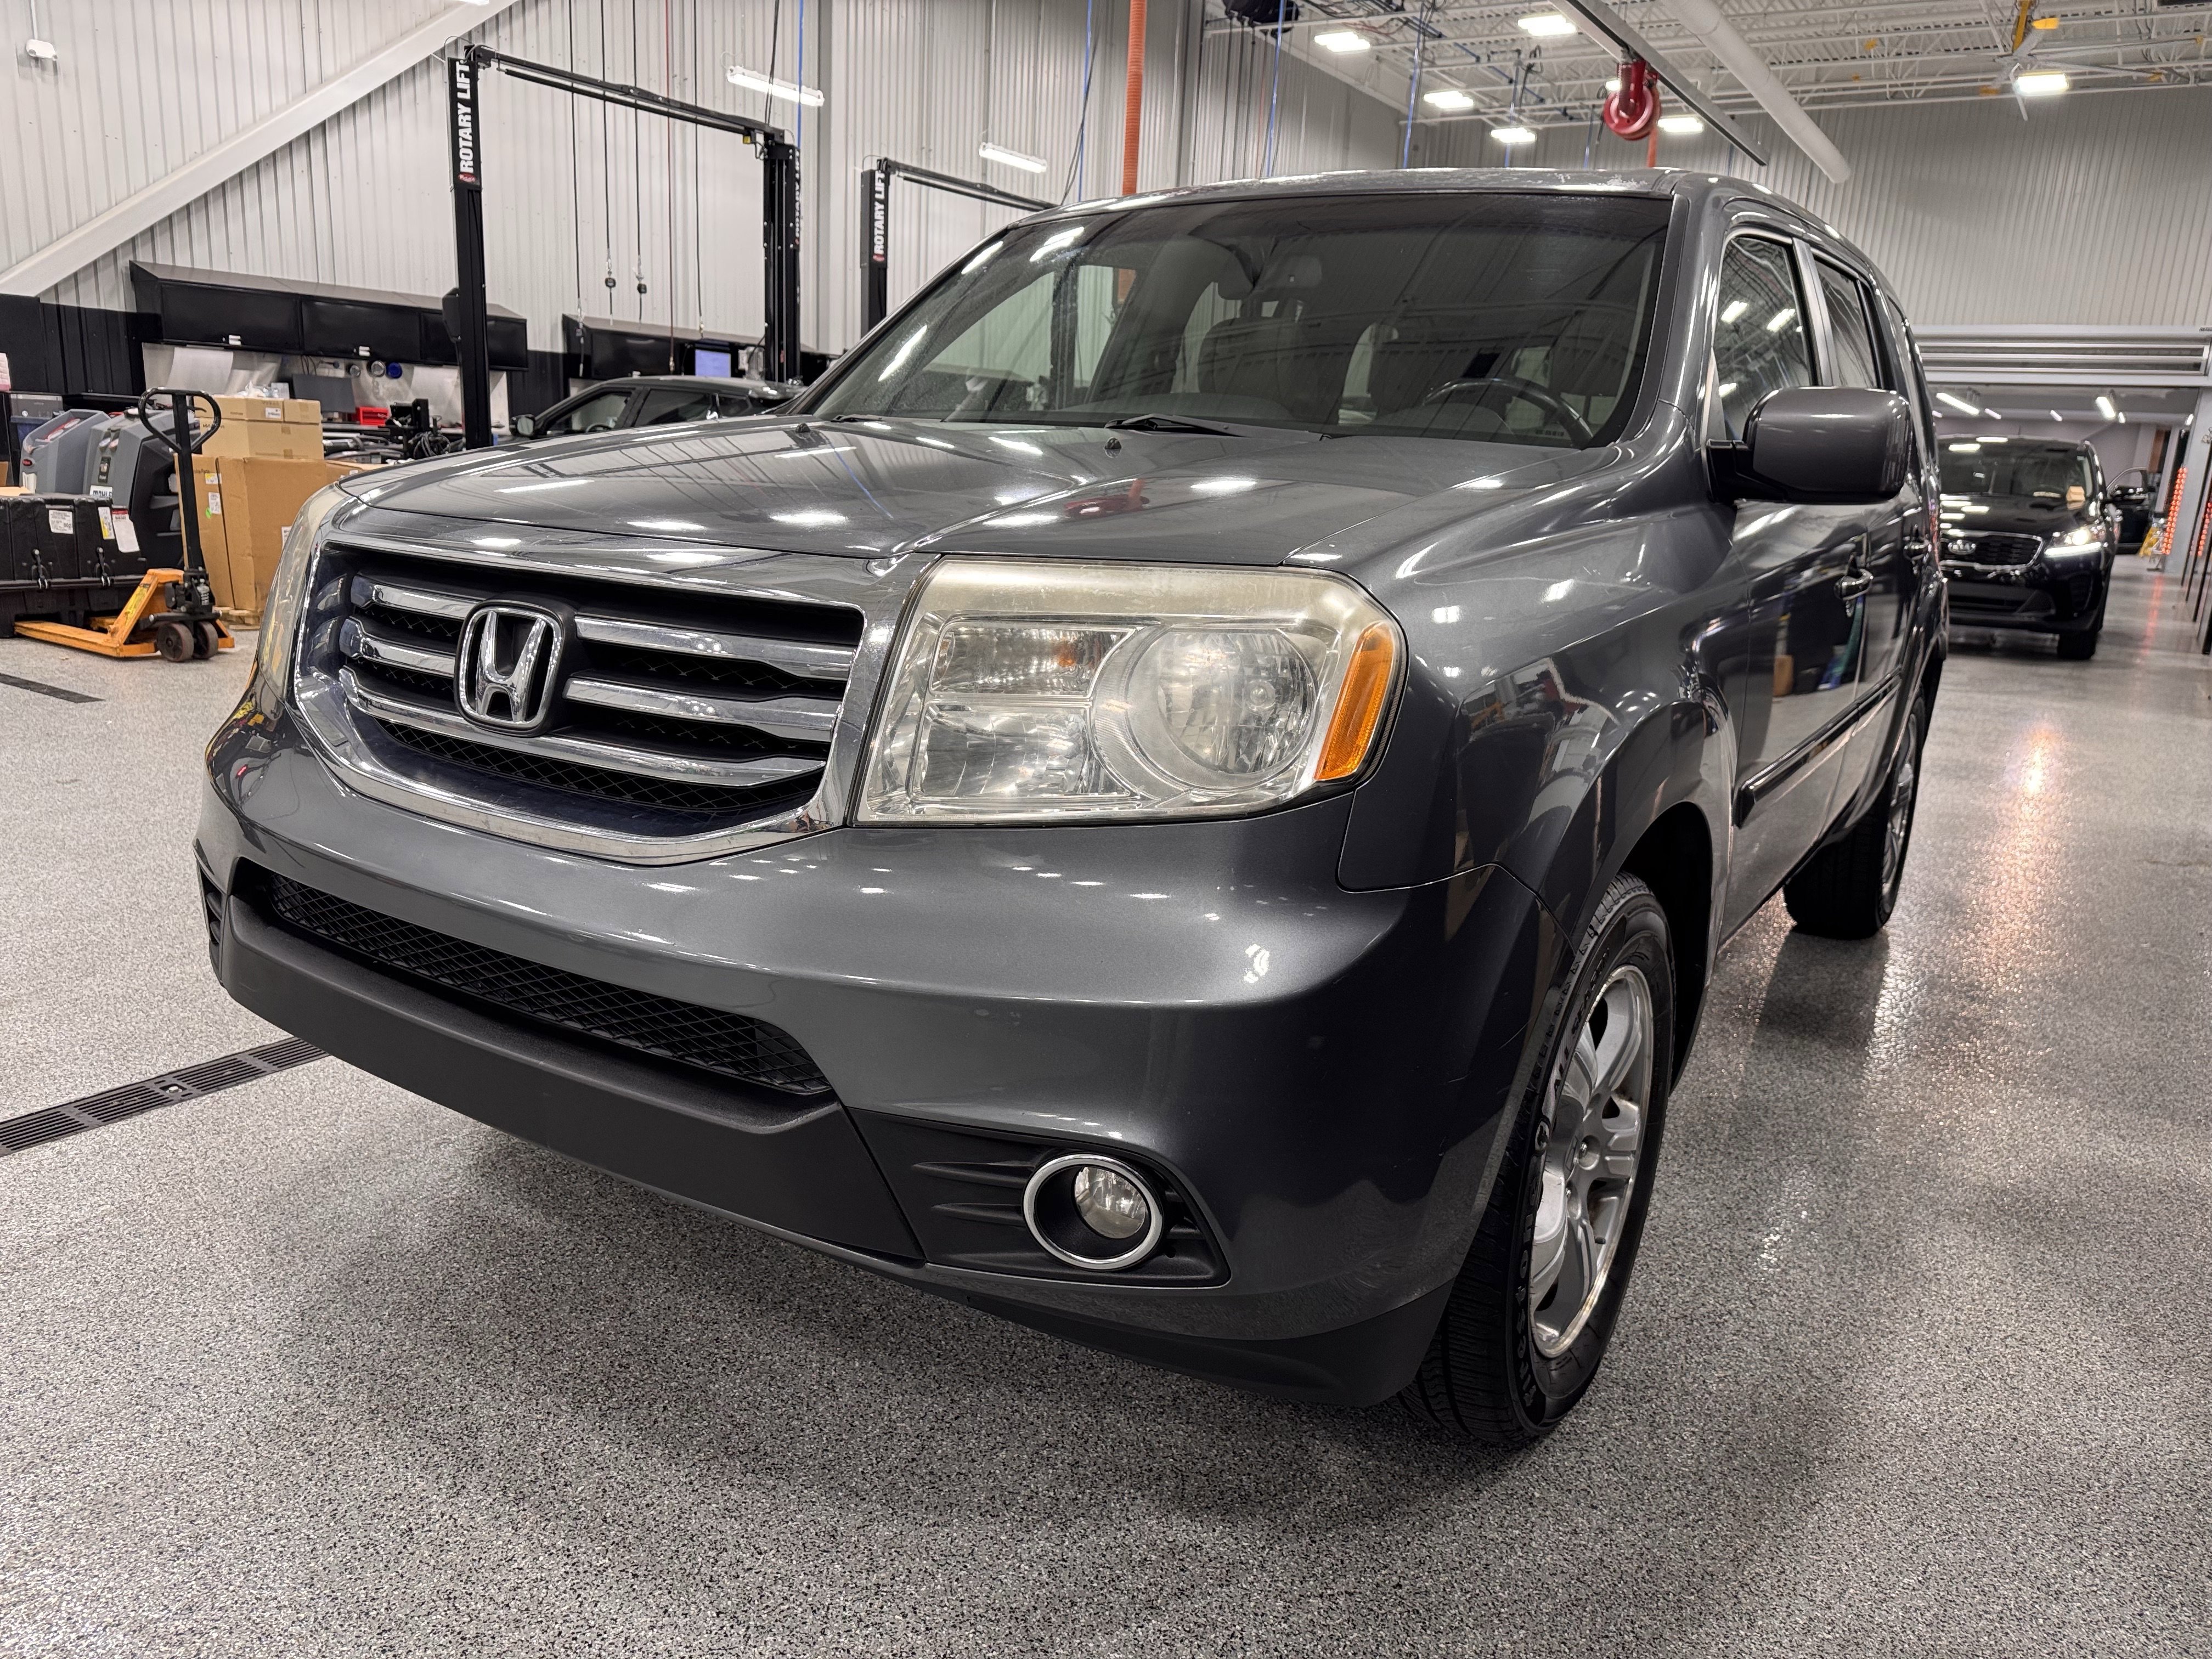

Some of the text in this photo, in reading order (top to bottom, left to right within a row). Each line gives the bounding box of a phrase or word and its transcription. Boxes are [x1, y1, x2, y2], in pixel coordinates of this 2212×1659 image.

[456, 61, 471, 100] LIFT
[457, 102, 474, 173] ROTARY
[874, 171, 885, 199] LIFT
[873, 201, 885, 255] ROTARY
